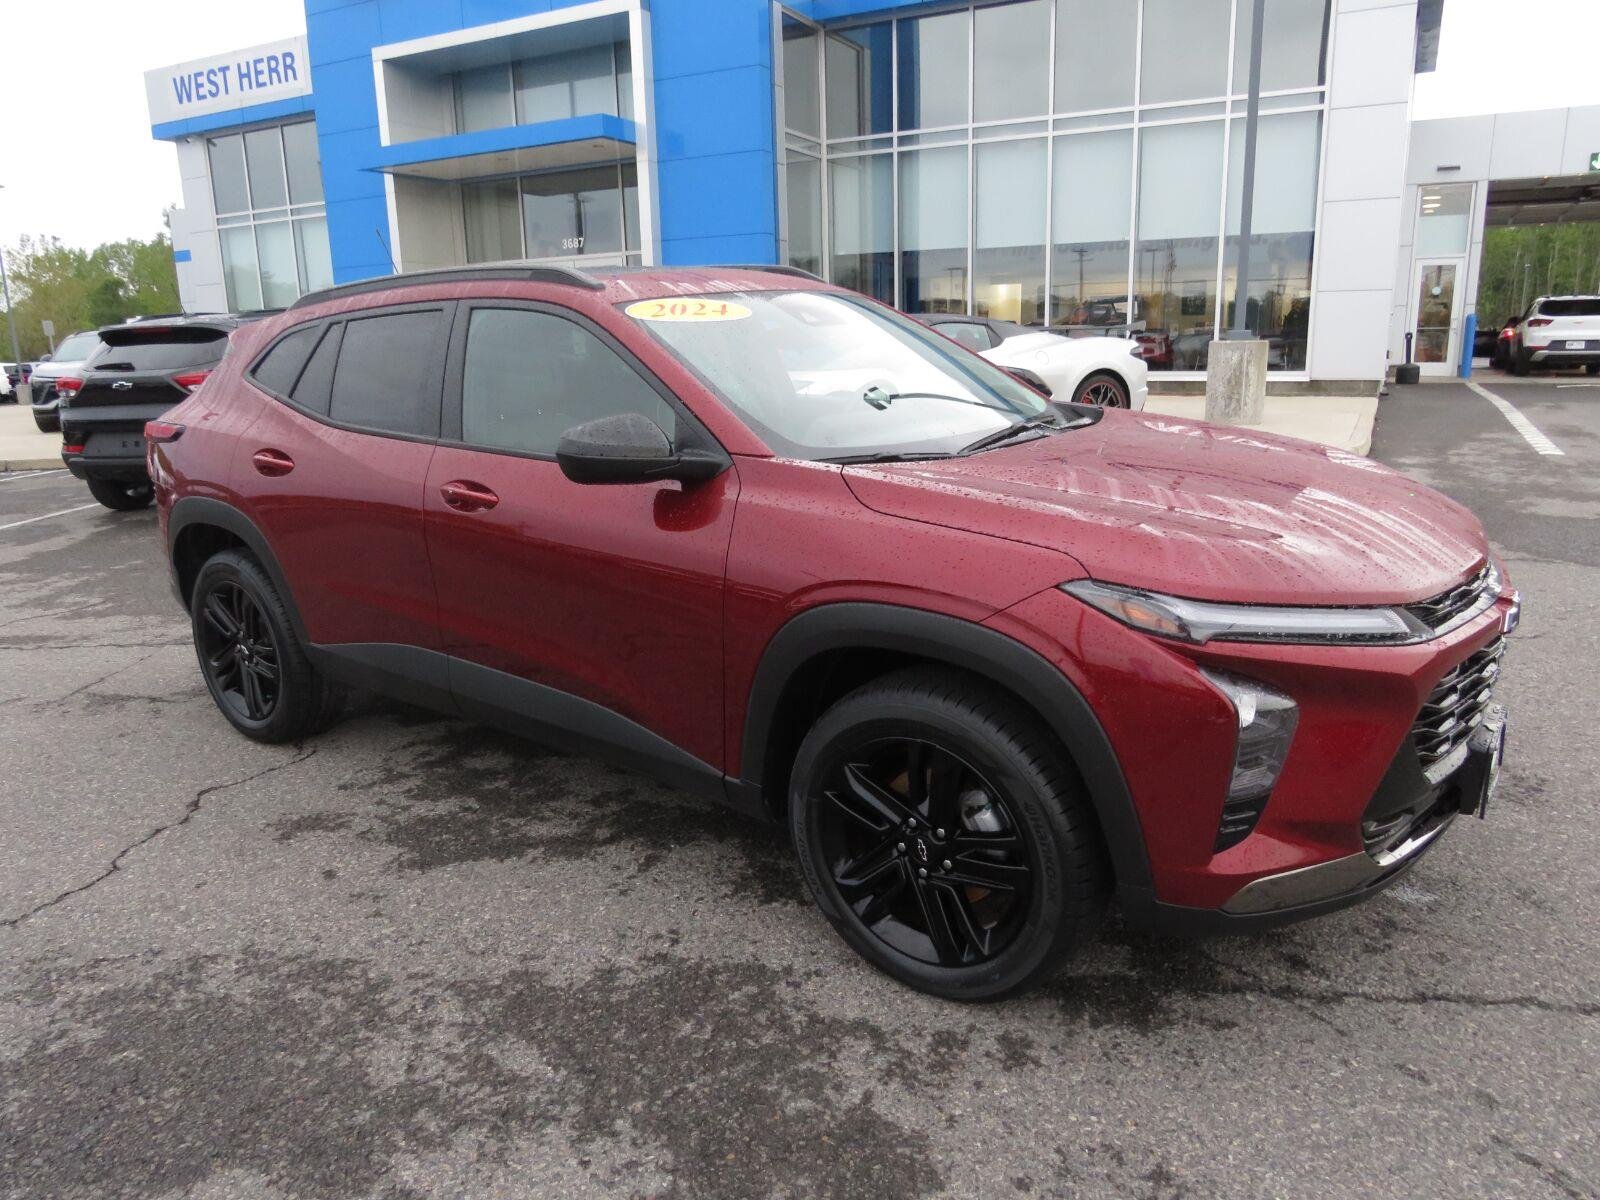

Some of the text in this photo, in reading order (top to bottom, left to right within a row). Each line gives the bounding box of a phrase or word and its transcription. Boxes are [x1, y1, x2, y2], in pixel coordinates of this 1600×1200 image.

[173, 52, 297, 104] WEST HERR
[561, 237, 585, 249] 3687
[651, 304, 728, 317] 2024
